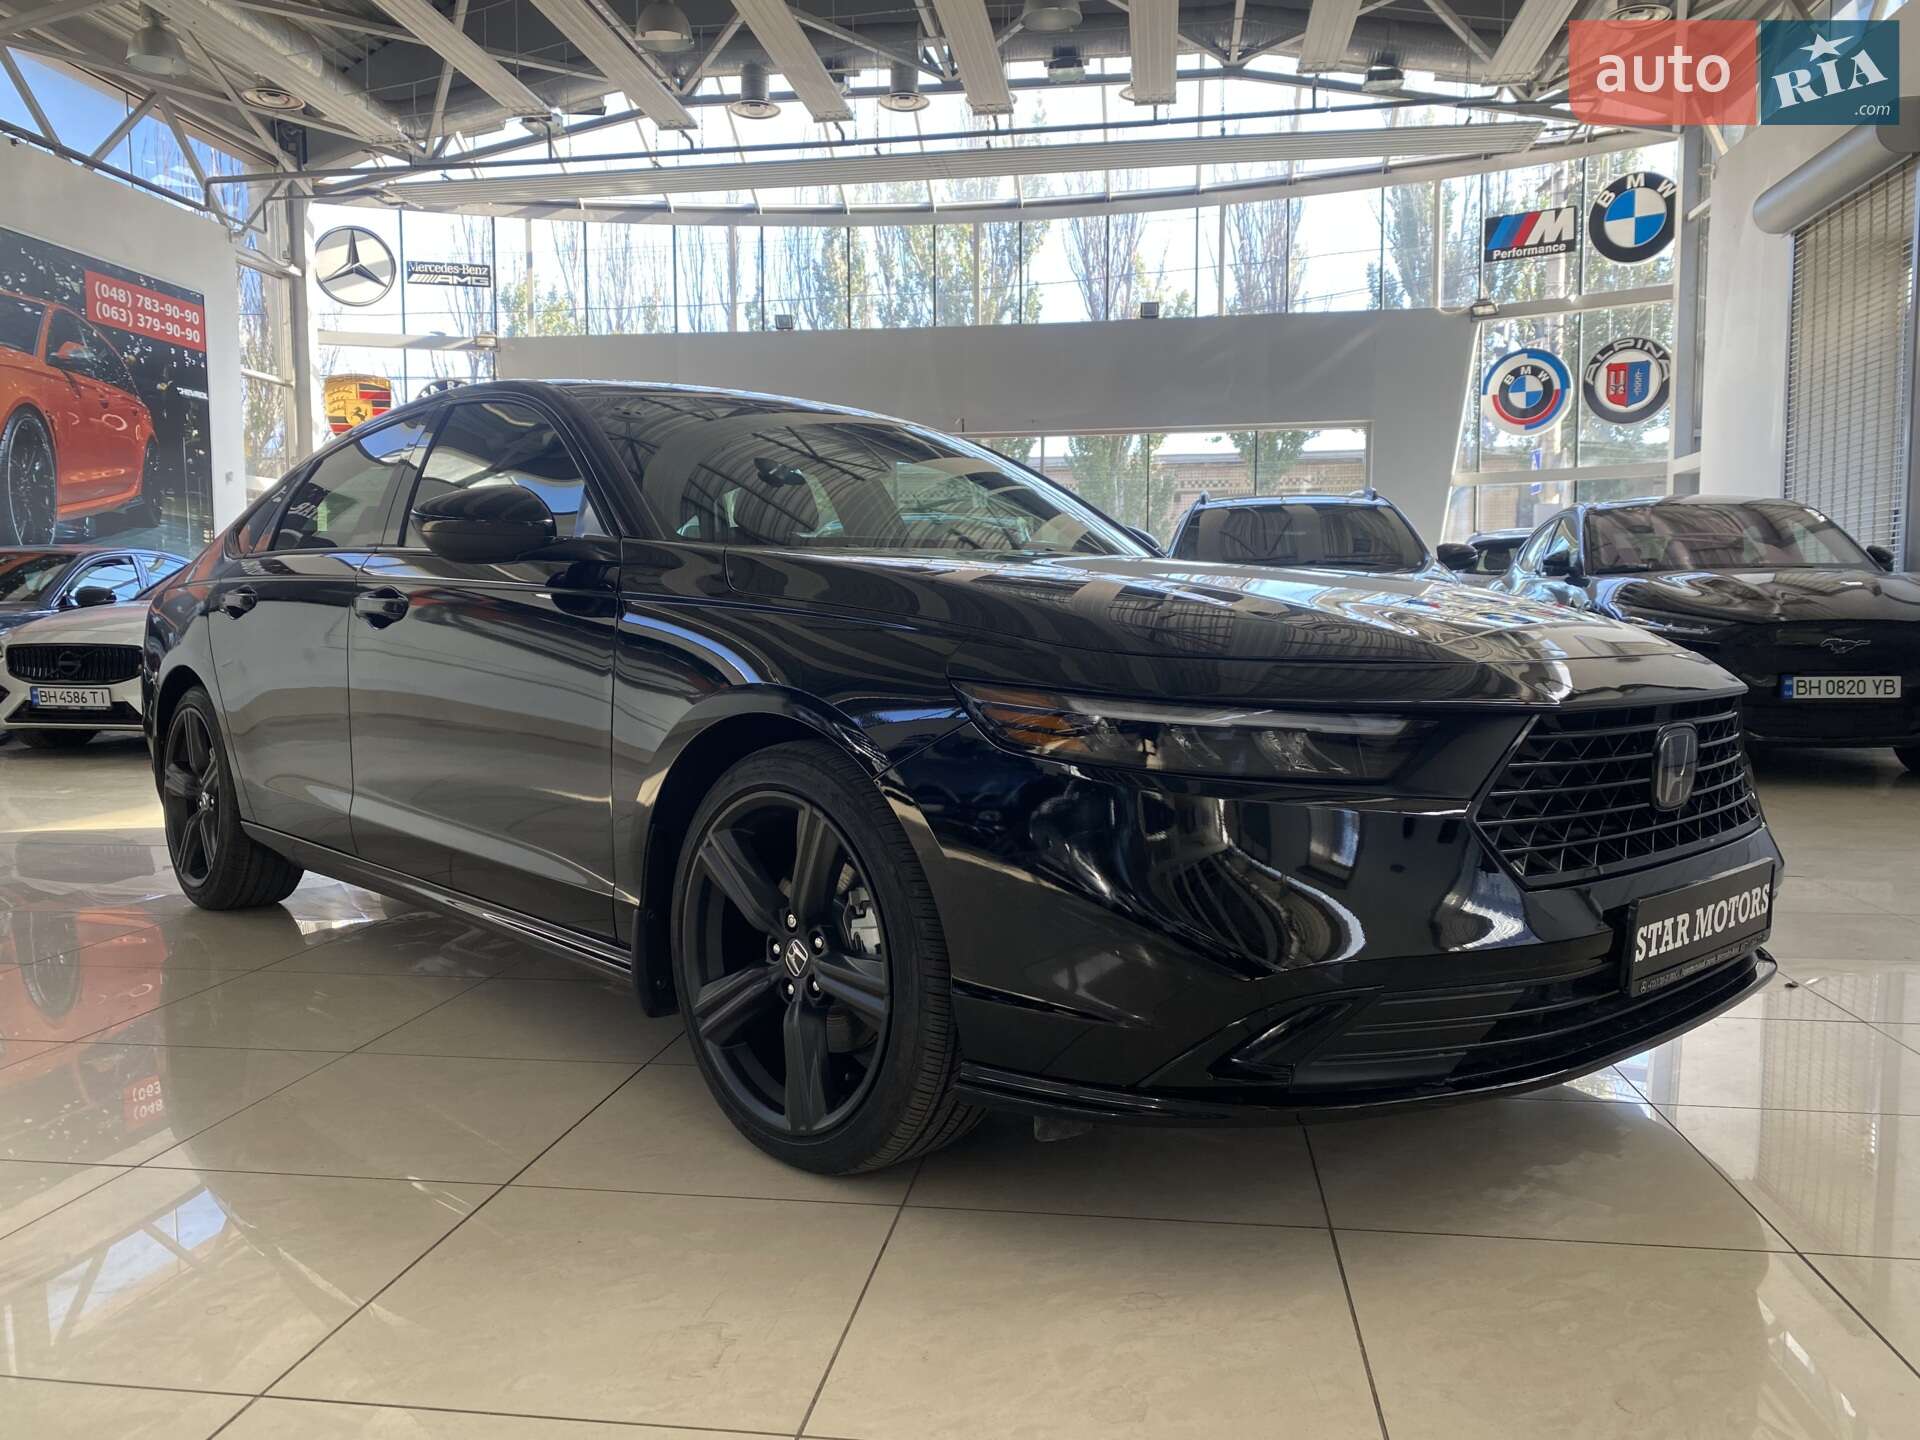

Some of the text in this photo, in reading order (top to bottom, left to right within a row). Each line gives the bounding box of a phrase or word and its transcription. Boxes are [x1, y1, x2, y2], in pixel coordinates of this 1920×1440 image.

[1598, 173, 1676, 208] BMW
[1493, 243, 1566, 260] Performance
[408, 261, 488, 276] Mercedes-Benz
[95, 281, 200, 325] (048) 783-90-90
[96, 302, 200, 343] (063) 379-90-90
[1585, 338, 1671, 386] ALPINA
[1504, 366, 1550, 386] BMW
[40, 690, 57, 703] BH
[60, 691, 88, 704] 4586
[90, 691, 105, 704] TI
[1796, 679, 1896, 696] BH 0820 YB
[1634, 883, 1770, 962] STAR MOTORS
